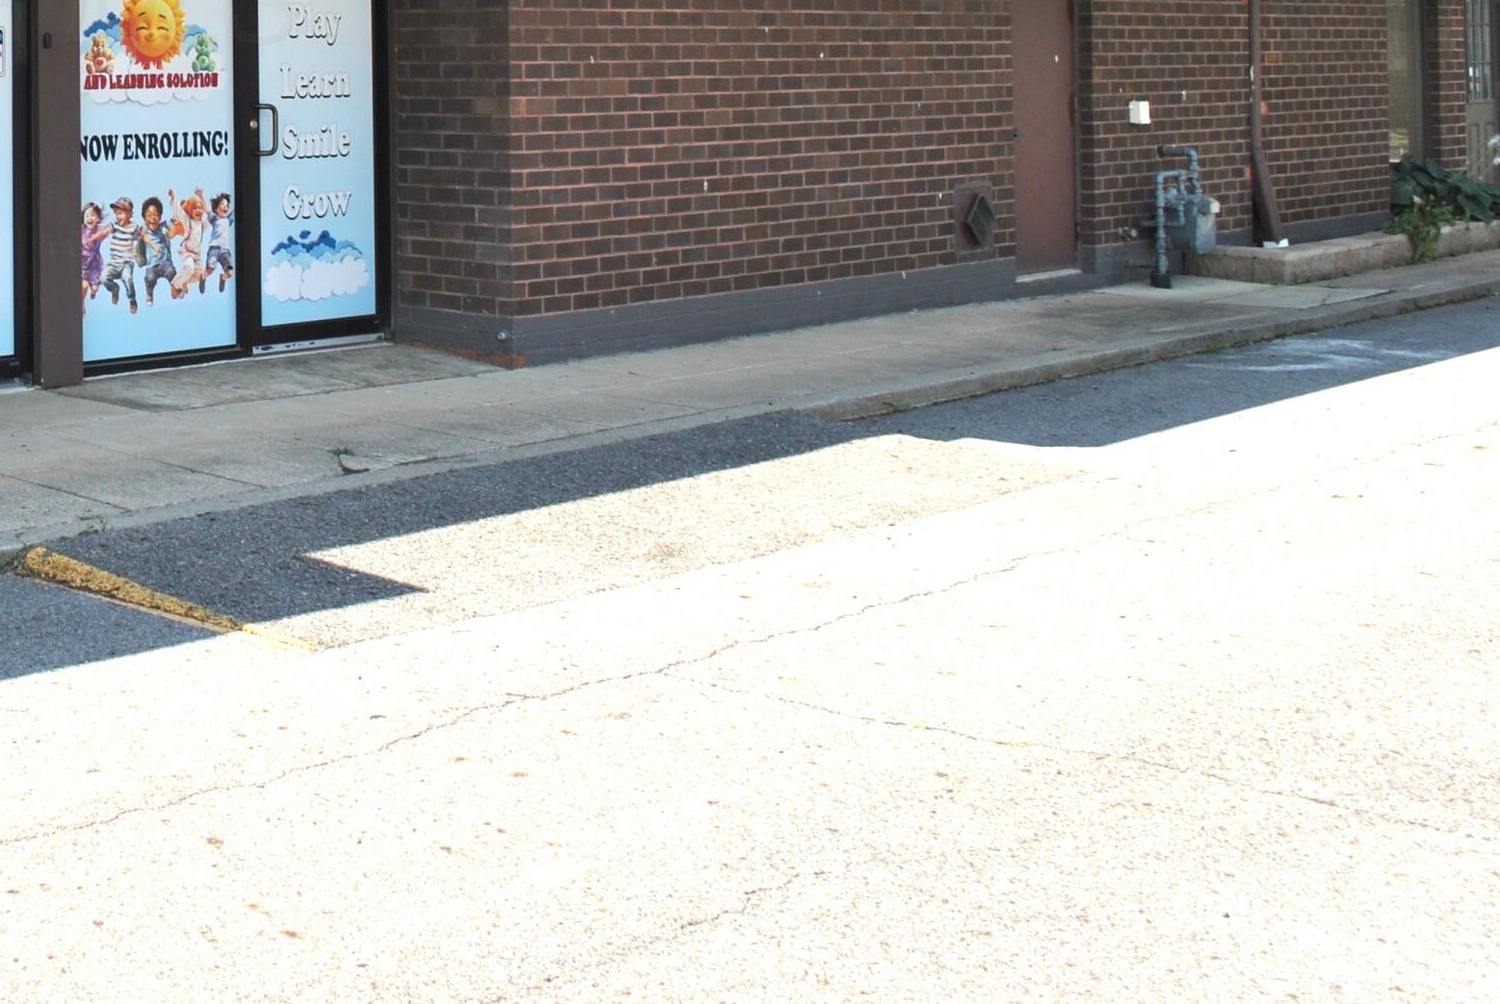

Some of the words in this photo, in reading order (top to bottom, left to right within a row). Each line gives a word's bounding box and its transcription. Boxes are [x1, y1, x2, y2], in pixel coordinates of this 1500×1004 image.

[287, 3, 342, 46] Play
[84, 74, 107, 90] AND
[109, 73, 165, 89] LEARNING
[279, 63, 351, 100] Learn
[80, 134, 118, 162] NOW
[122, 130, 228, 160] ENROLLING!
[281, 123, 351, 160] Smile
[281, 184, 351, 220] Grow
